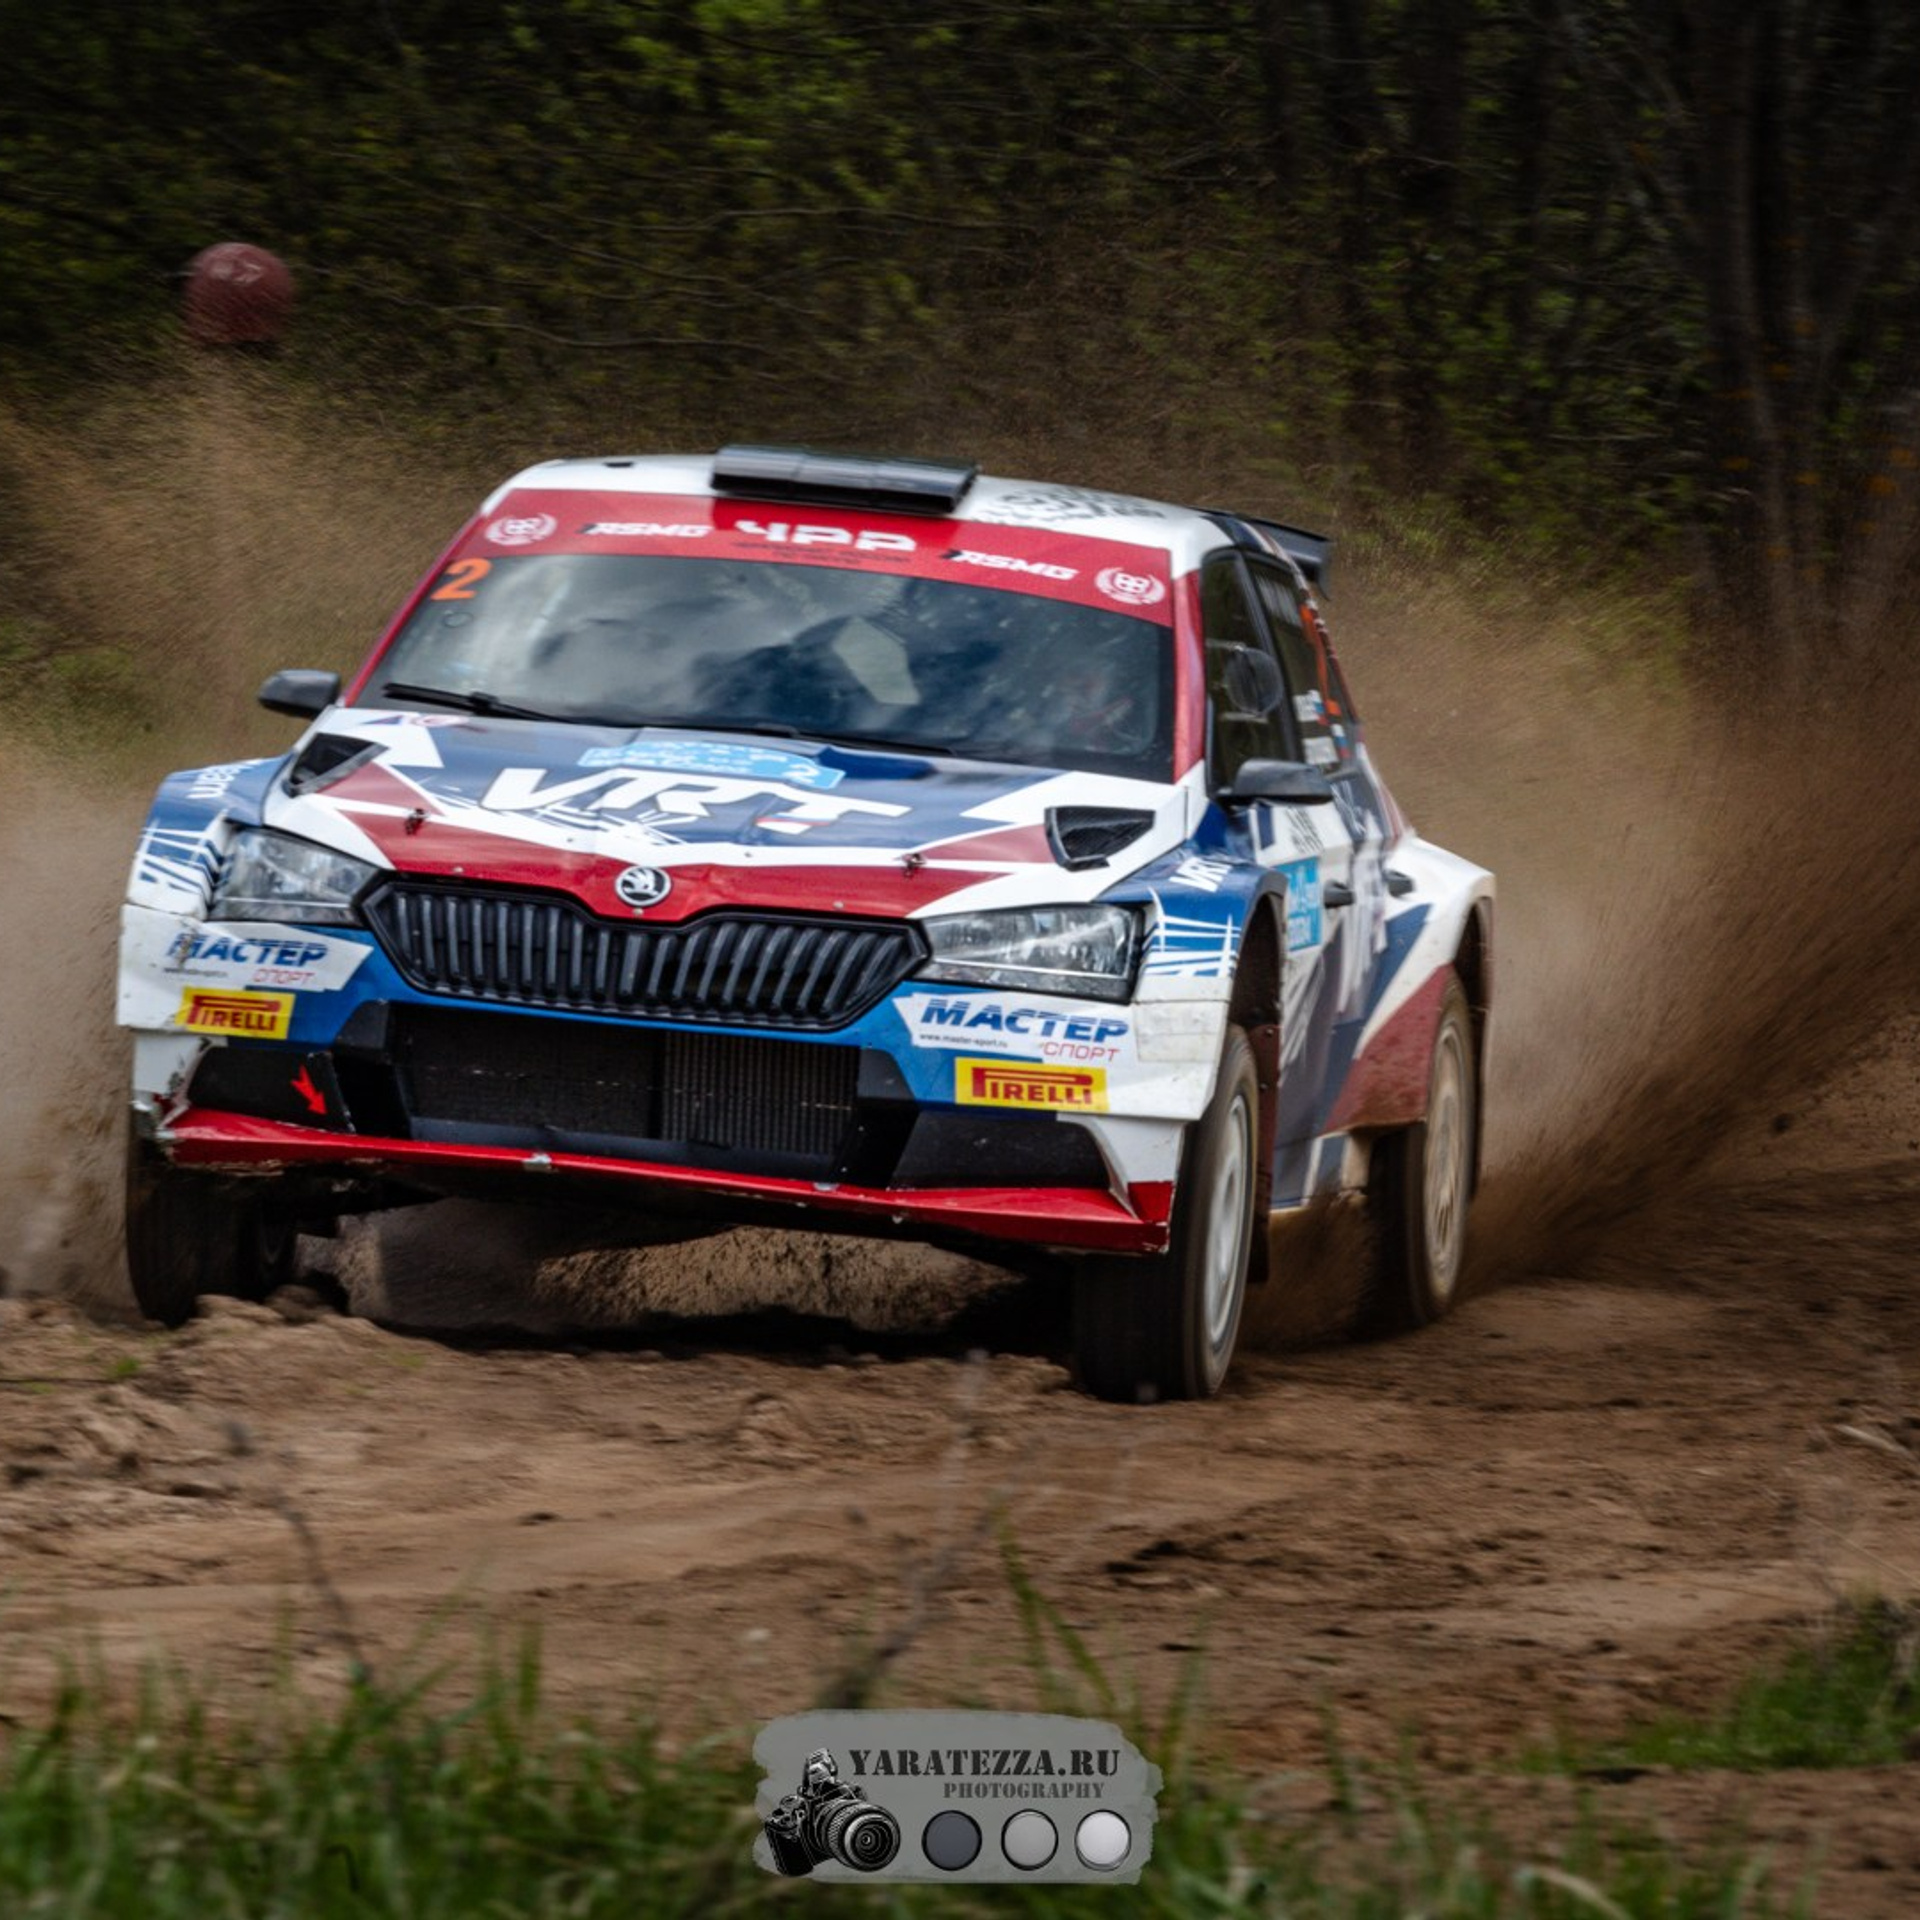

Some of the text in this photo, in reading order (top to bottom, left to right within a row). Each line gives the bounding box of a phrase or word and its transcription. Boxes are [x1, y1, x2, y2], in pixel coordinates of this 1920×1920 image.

[734, 519, 917, 552] ЧРР
[430, 558, 492, 600] 2
[480, 767, 913, 834] VRT
[187, 995, 281, 1031] PIRELLI
[921, 998, 1130, 1043] МАСТЕР
[1043, 1041, 1120, 1063] СПОРТ
[972, 1067, 1094, 1105] PIRELLI
